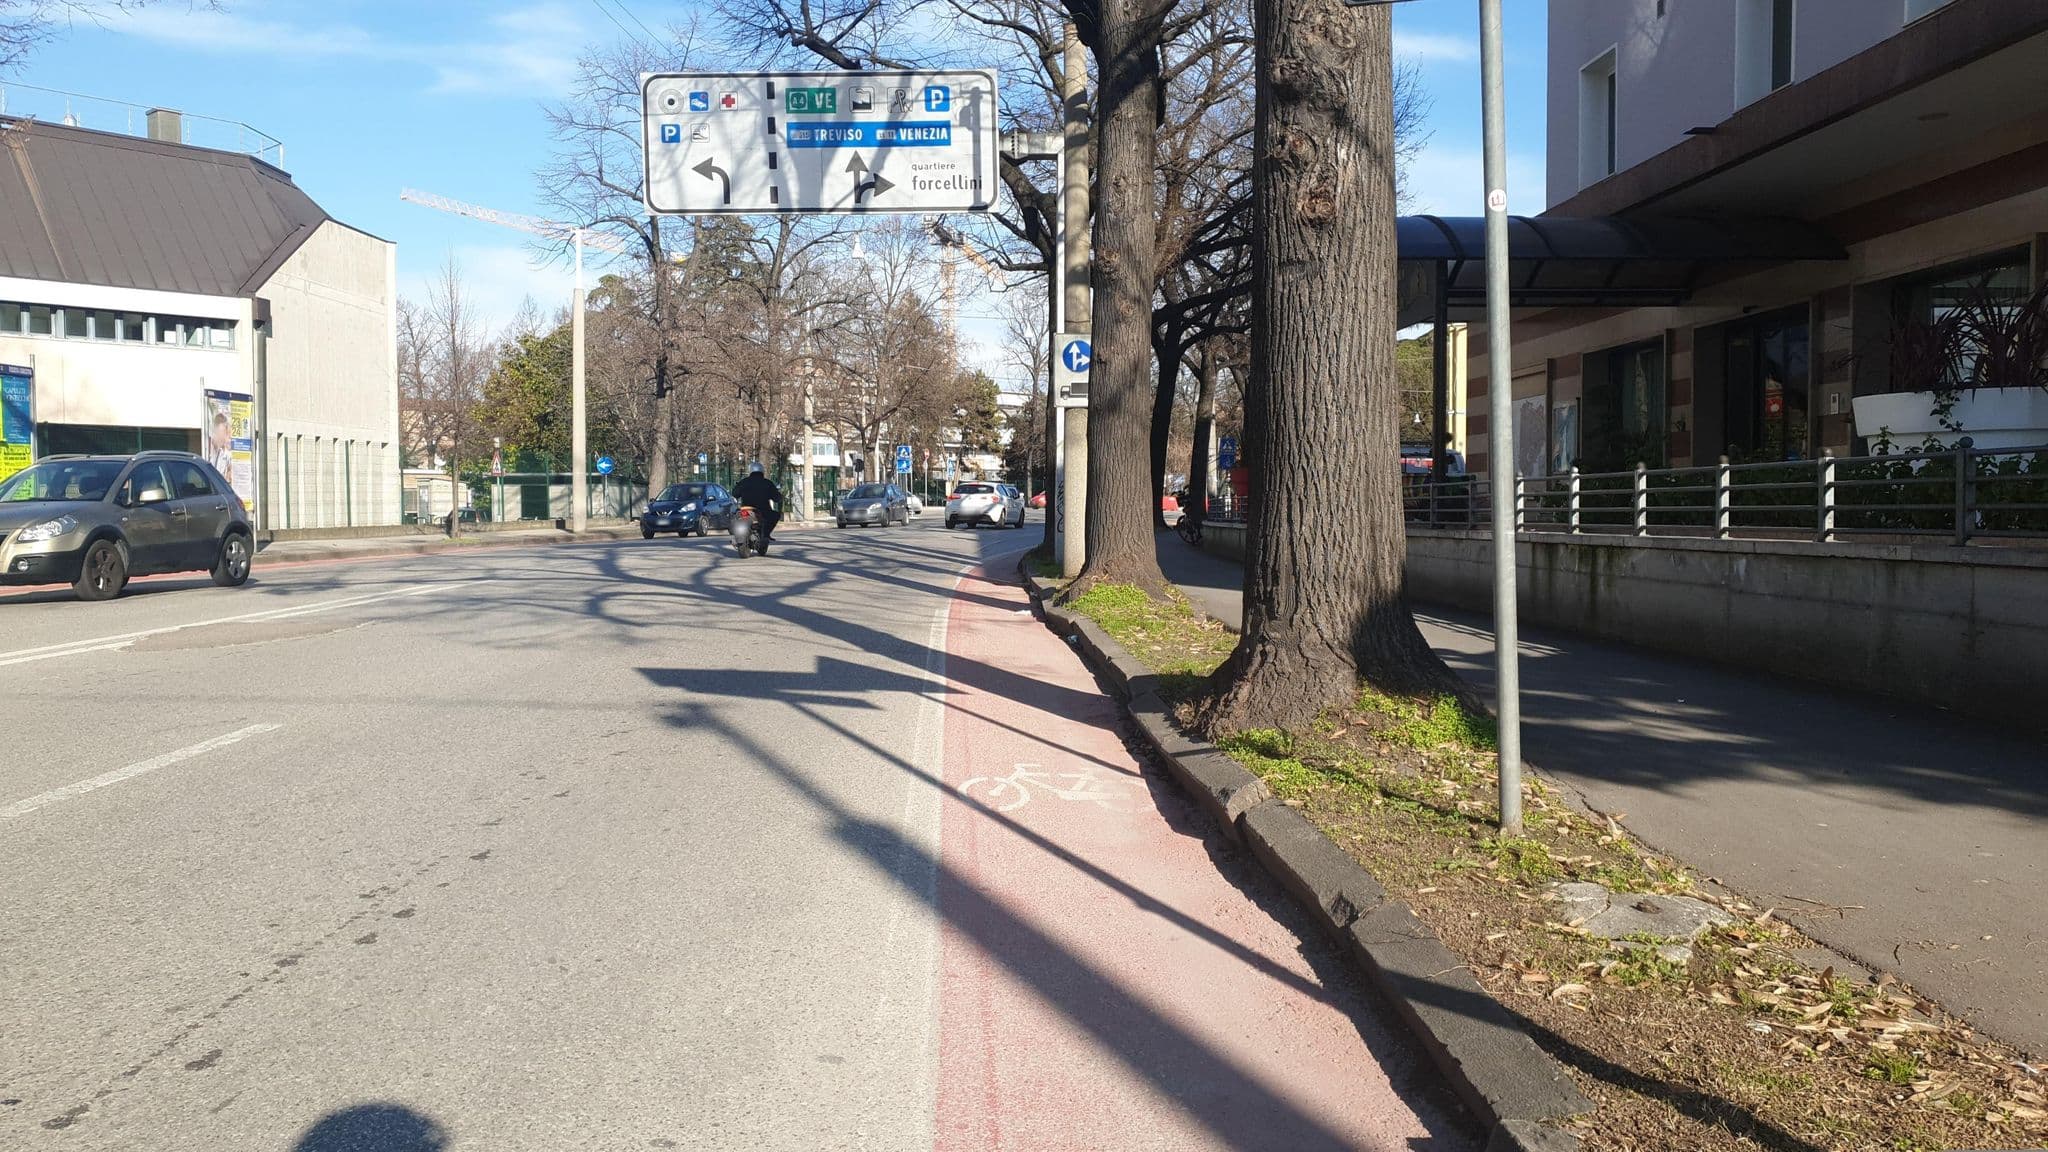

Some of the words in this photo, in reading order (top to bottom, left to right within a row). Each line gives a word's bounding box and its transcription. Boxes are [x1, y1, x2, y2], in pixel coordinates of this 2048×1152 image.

[814, 92, 833, 109] VE
[814, 128, 863, 141] TREVISO
[899, 127, 948, 140] VENEZIA
[911, 162, 956, 171] quartiere
[912, 174, 982, 190] forcellini
